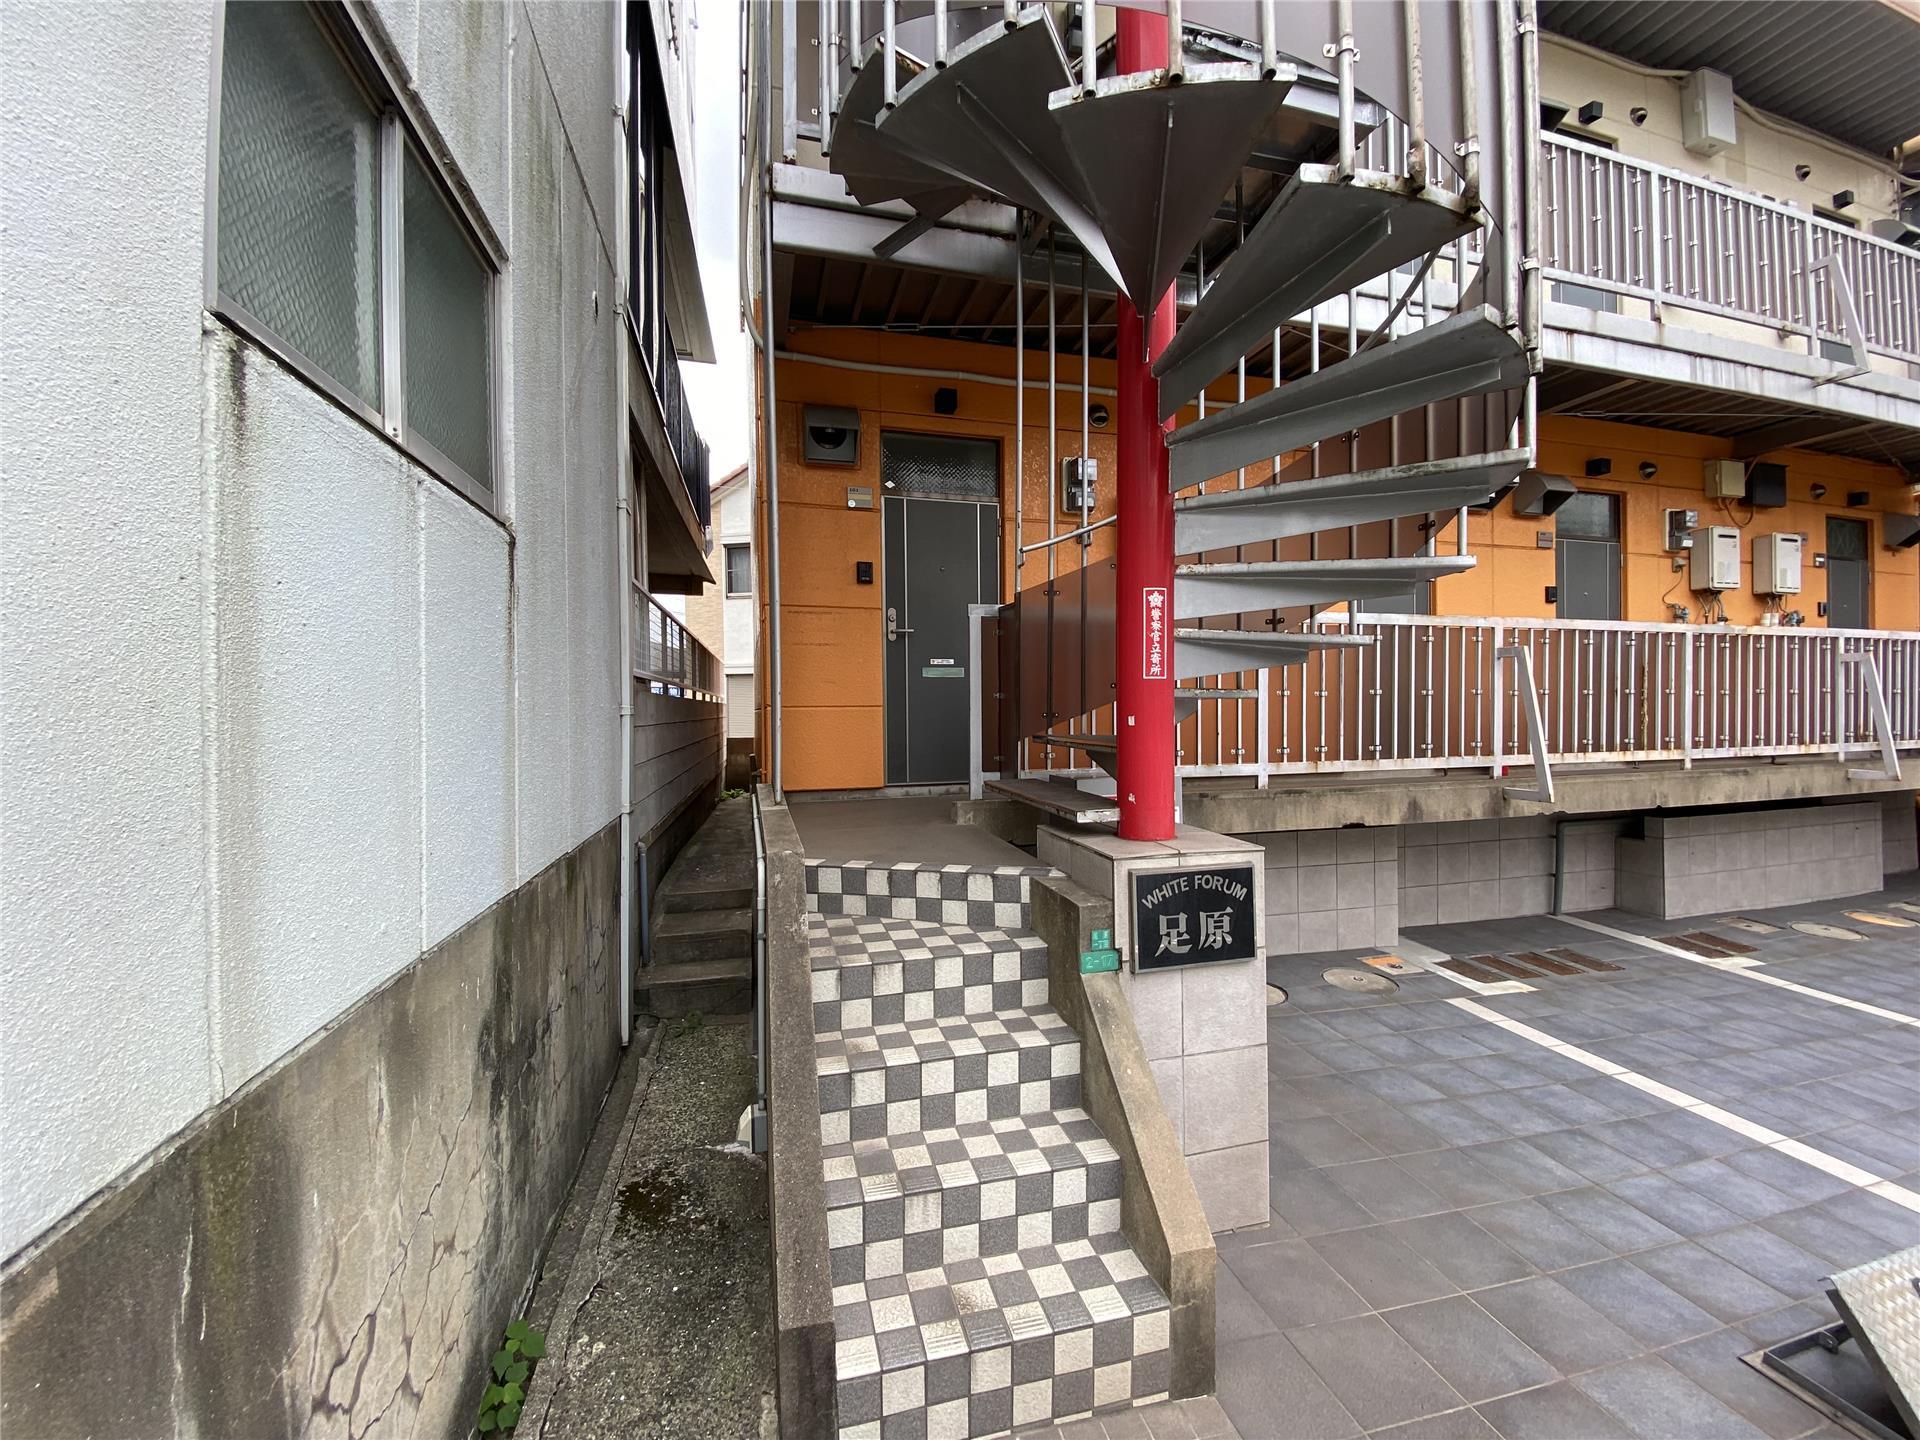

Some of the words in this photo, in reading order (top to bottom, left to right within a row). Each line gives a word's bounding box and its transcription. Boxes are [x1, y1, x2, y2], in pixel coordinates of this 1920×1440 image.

[1149, 607, 1163, 676] 警察官立寄所
[1141, 876, 1189, 909] WHITE
[1194, 874, 1248, 901] FORUM
[1154, 906, 1234, 957] 足原
